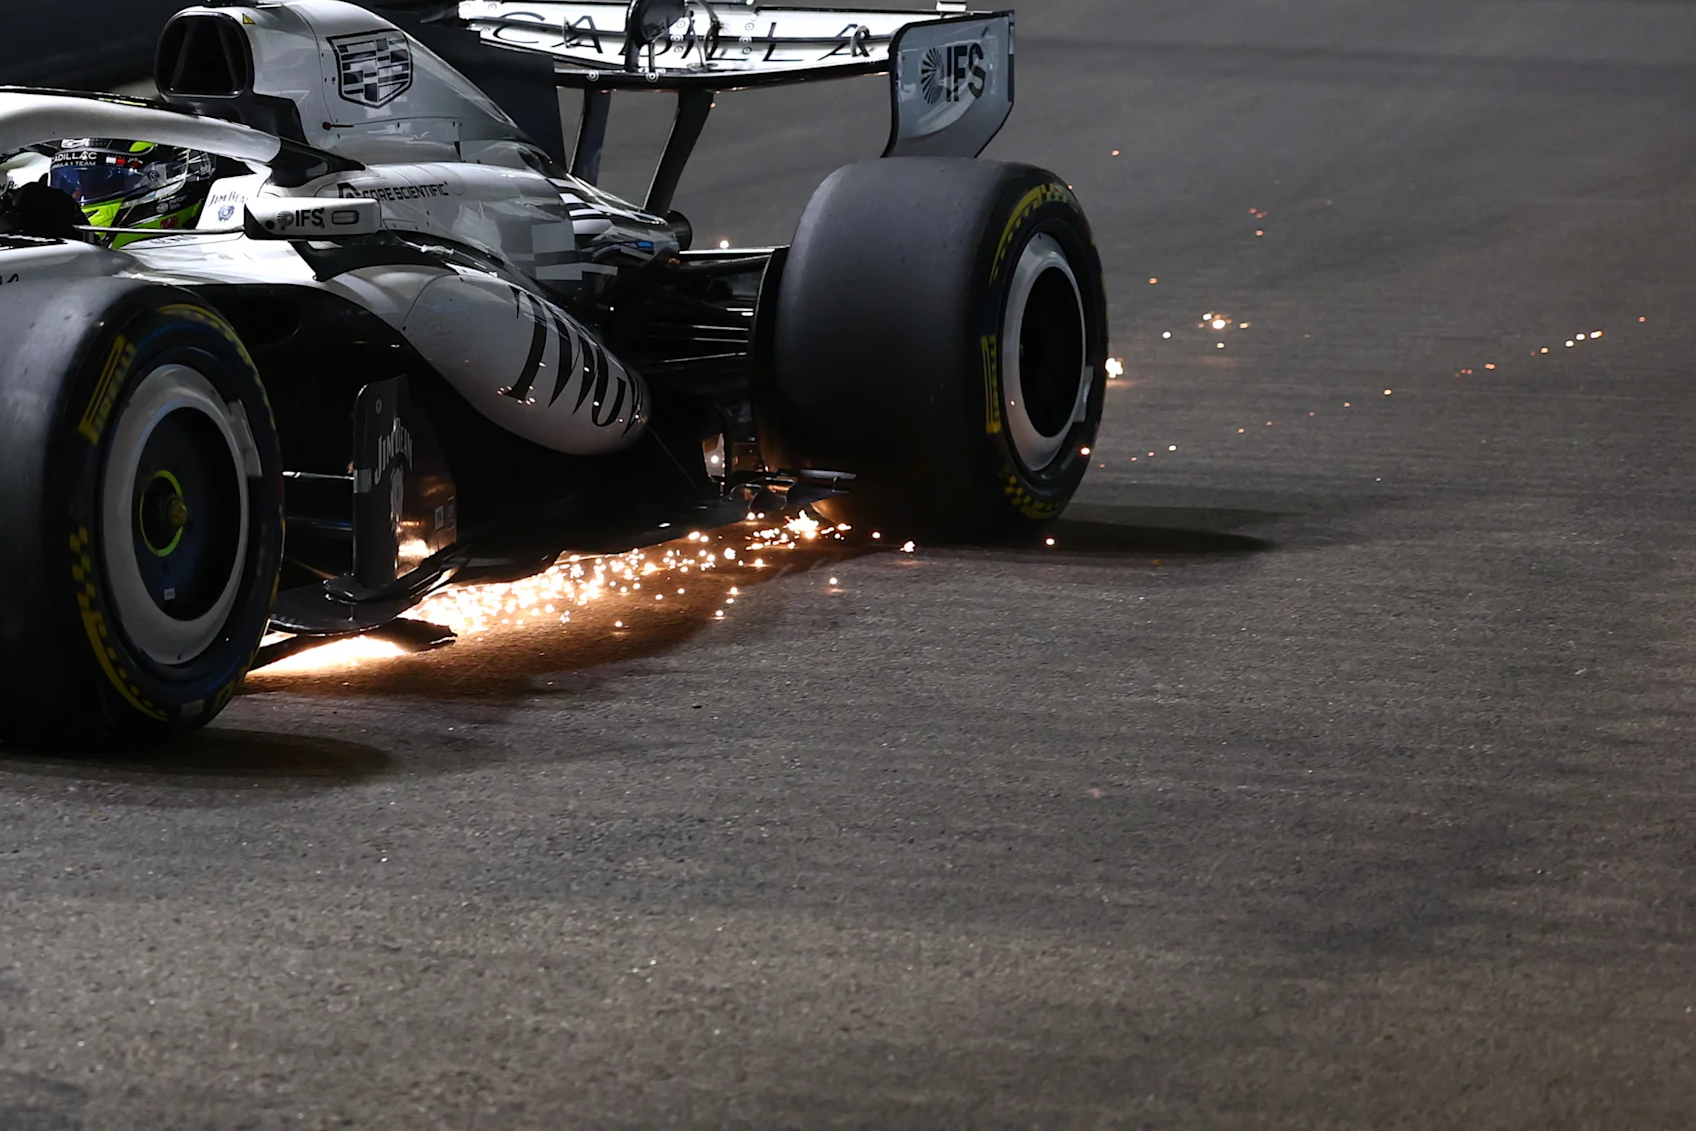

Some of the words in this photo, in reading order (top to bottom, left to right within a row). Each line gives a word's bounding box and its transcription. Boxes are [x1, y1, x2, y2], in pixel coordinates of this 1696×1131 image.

[946, 43, 985, 102] IFS
[394, 182, 449, 200] SCIENTIFIC
[295, 208, 324, 227] IFS
